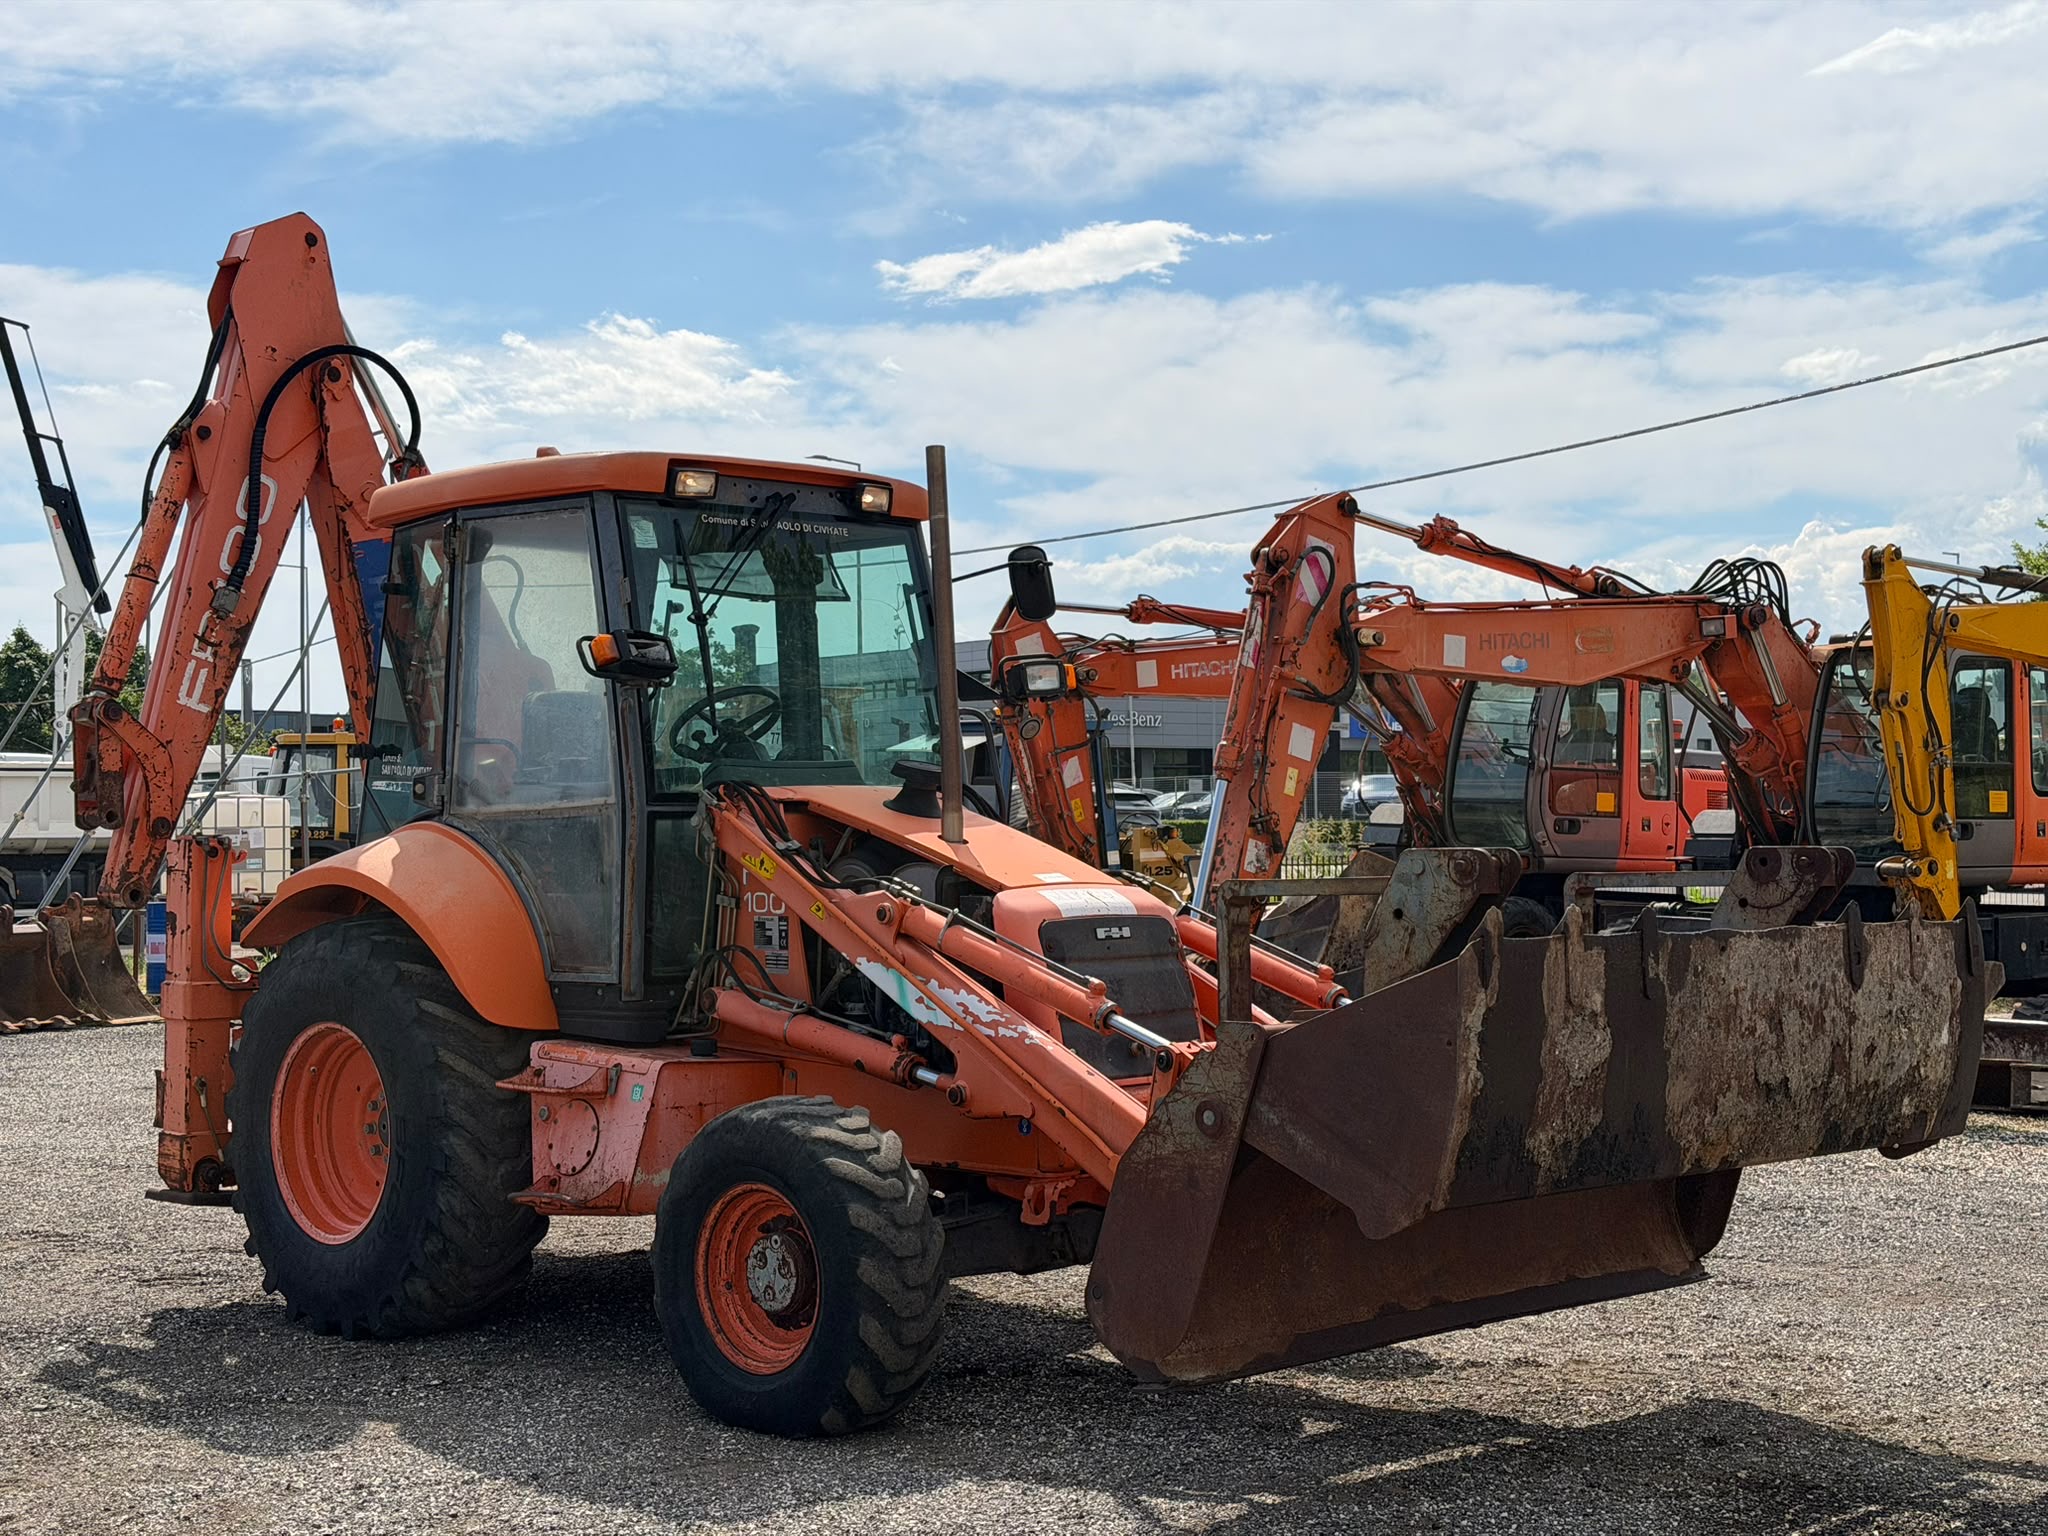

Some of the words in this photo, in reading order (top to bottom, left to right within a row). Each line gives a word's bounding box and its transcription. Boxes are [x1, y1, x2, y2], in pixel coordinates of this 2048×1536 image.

[701, 514, 738, 526] Comune
[740, 518, 748, 527] di
[771, 520, 801, 532] AOLO
[802, 523, 812, 533] DI
[1479, 631, 1550, 651] HITACHI
